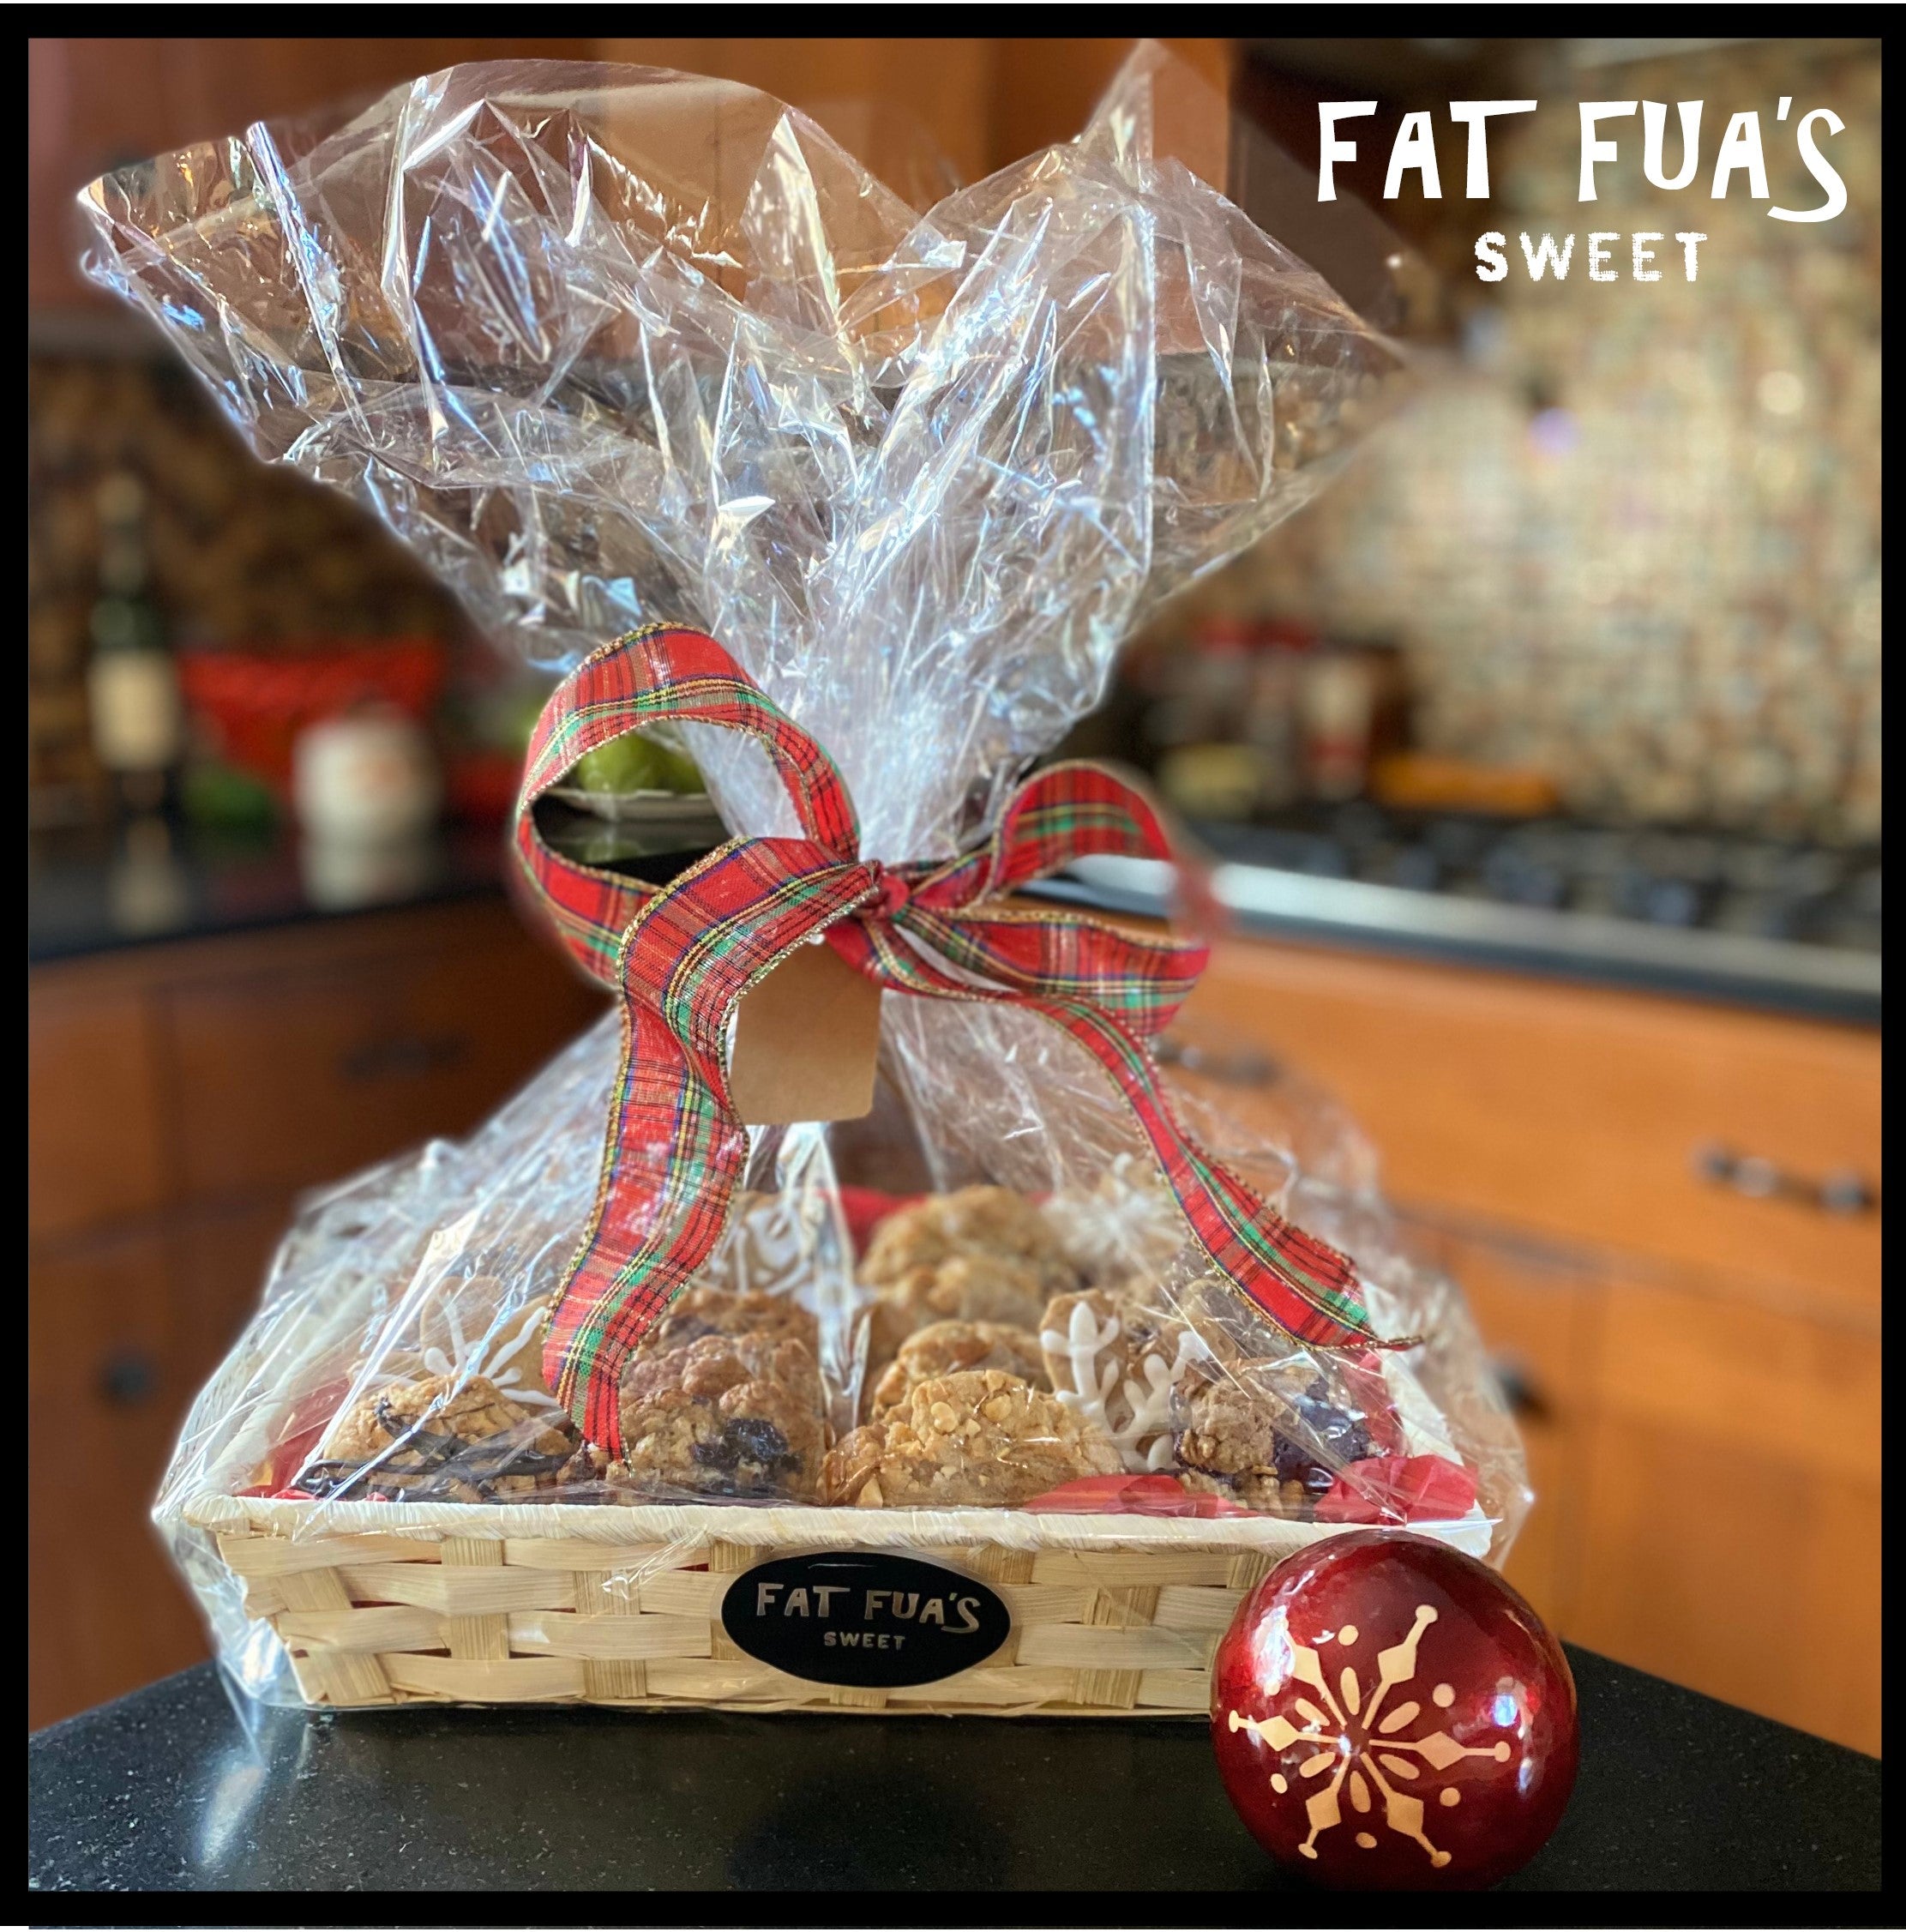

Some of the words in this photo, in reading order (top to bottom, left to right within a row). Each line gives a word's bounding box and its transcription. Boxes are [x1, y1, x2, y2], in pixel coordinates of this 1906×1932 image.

[756, 1582, 851, 1617] FAT
[864, 1590, 980, 1634] FUA'S
[824, 1631, 905, 1651] SWEET
